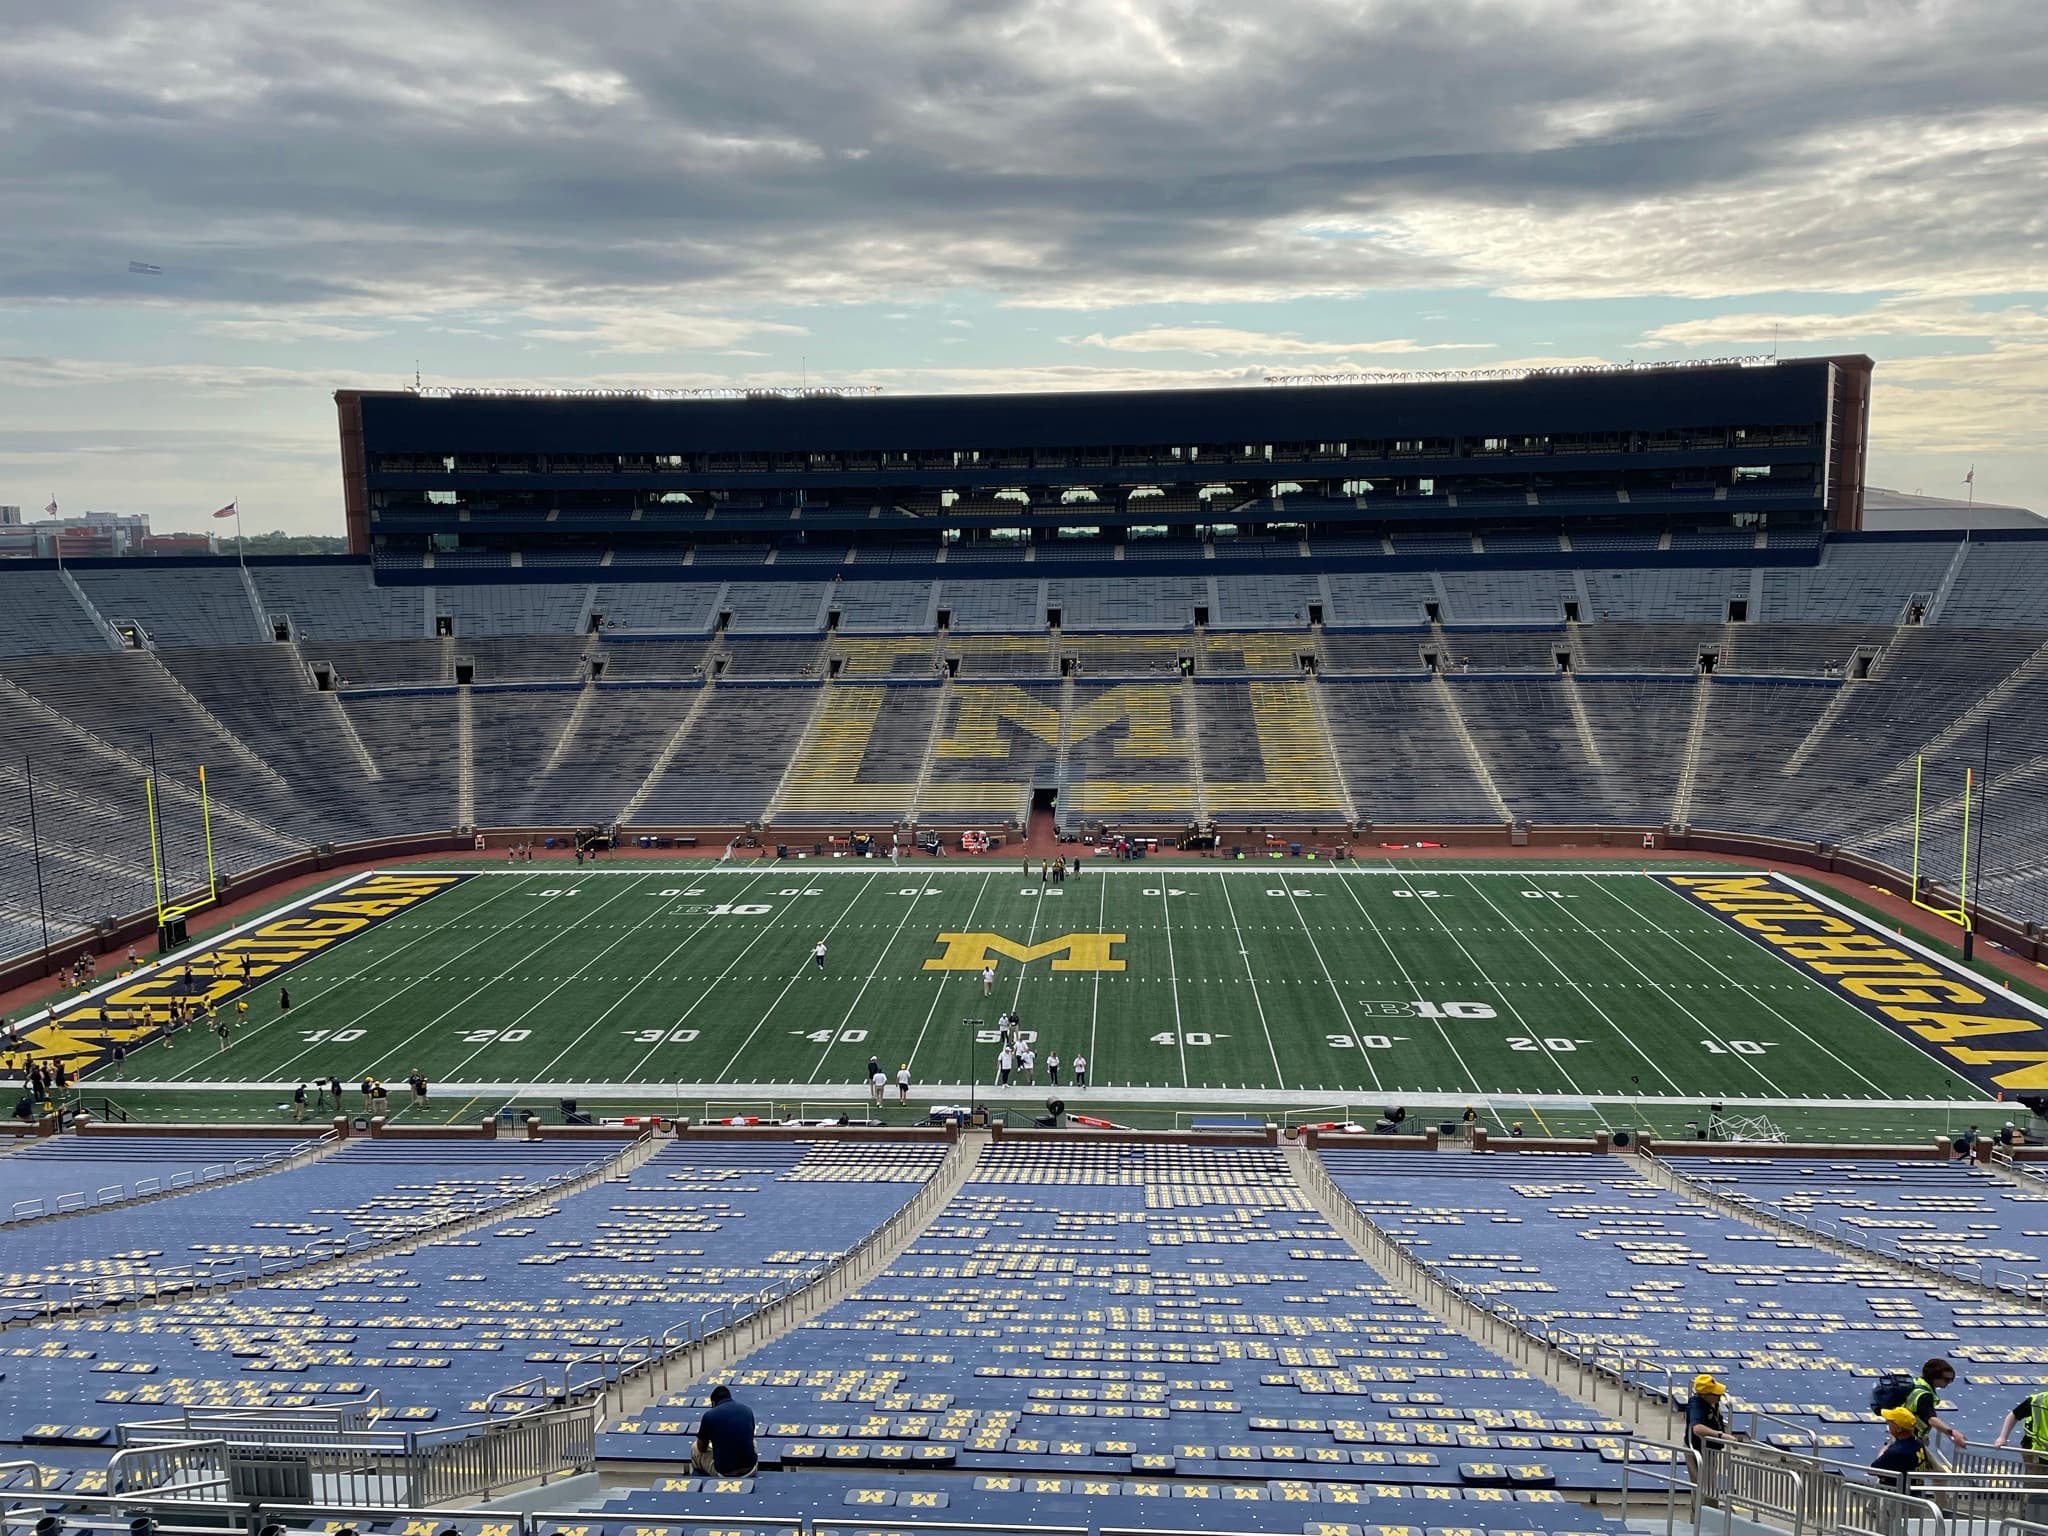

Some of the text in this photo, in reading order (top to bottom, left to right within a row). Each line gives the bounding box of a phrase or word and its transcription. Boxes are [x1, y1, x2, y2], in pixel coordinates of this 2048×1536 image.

[921, 933, 1127, 971] M
[0, 876, 459, 1075] MICHIGAN
[301, 1029, 368, 1042] 10
[461, 1029, 533, 1042] 20
[632, 1029, 700, 1043] 30
[805, 1029, 868, 1043] 40
[976, 1030, 1038, 1043] 50
[1150, 1032, 1211, 1046] 40
[1325, 1034, 1393, 1049] 30
[1504, 1037, 1577, 1052] 20
[1700, 1040, 1766, 1055] 10
